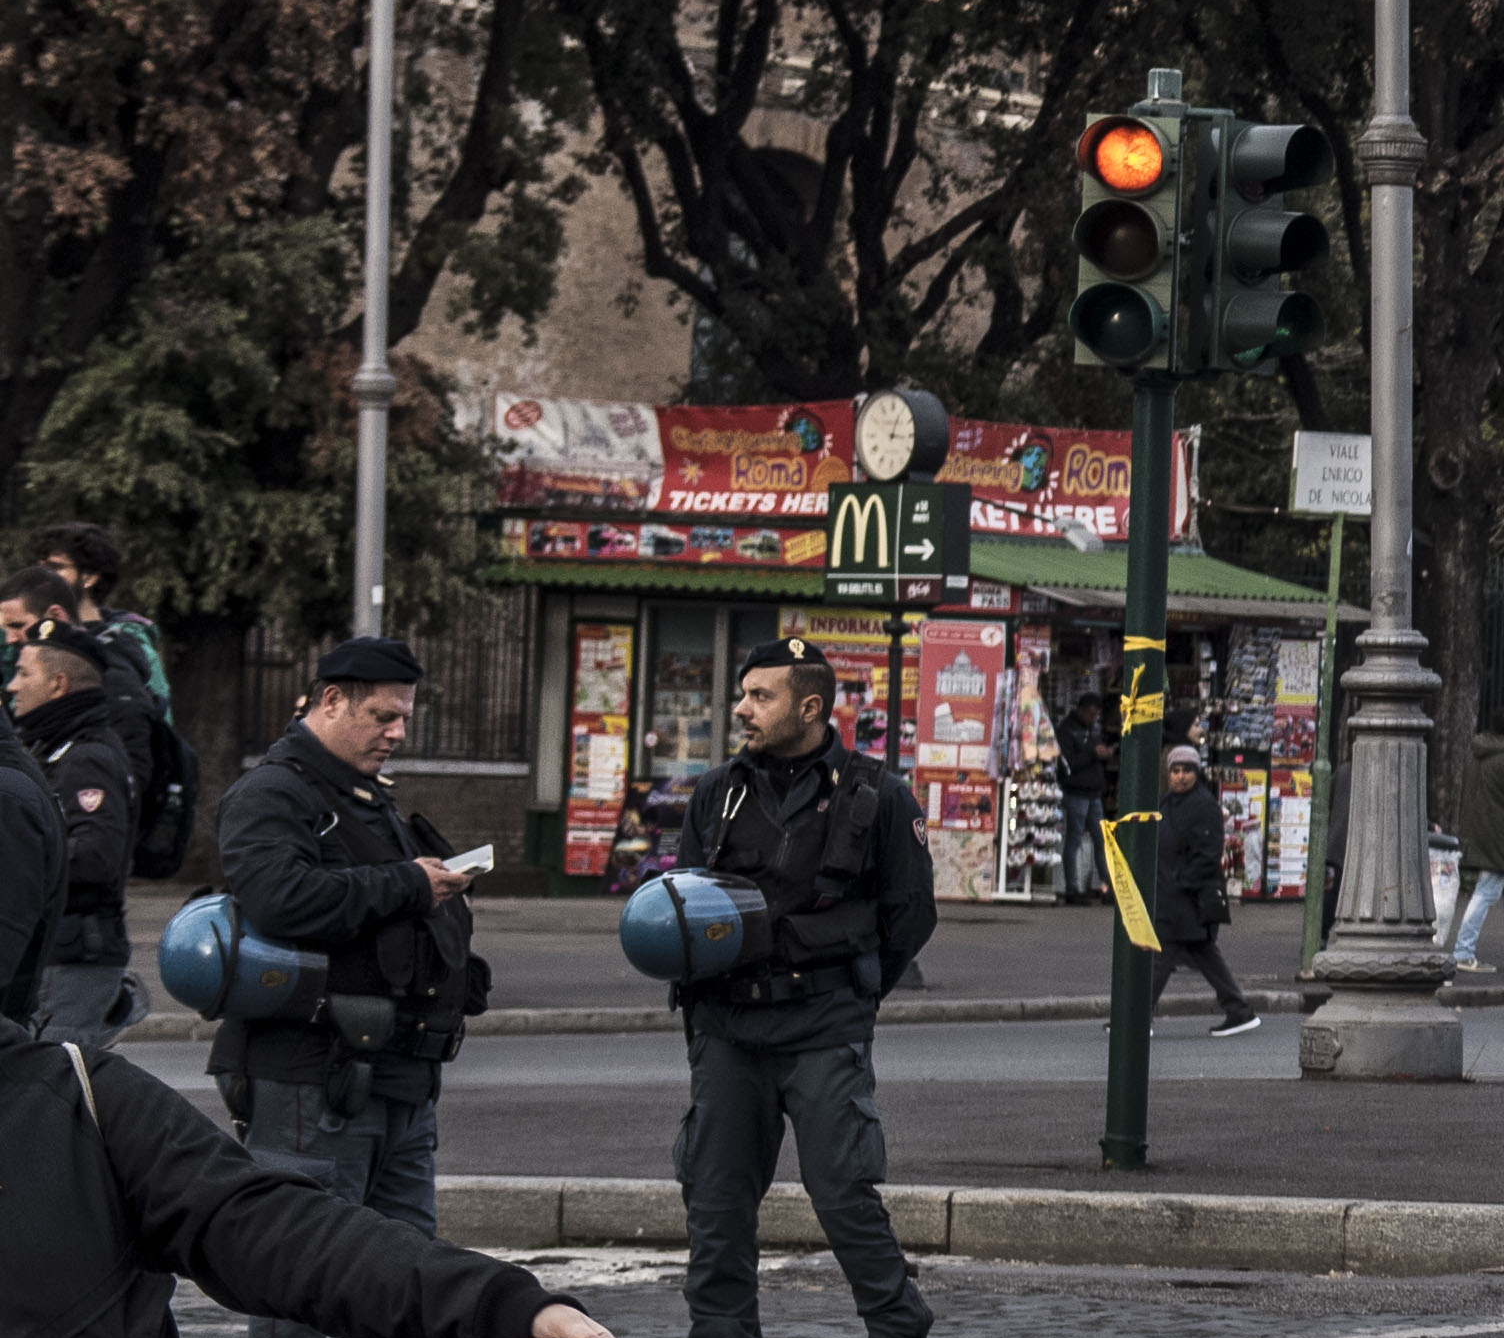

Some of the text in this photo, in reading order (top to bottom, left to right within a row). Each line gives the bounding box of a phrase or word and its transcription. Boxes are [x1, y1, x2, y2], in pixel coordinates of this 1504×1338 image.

[1329, 444, 1359, 460] VIALE
[1067, 446, 1130, 492] Rom
[1322, 467, 1363, 482] ENRICO
[669, 490, 828, 514] TICKETS HER
[1308, 489, 1323, 504] DE
[971, 499, 1118, 534] KET HERE
